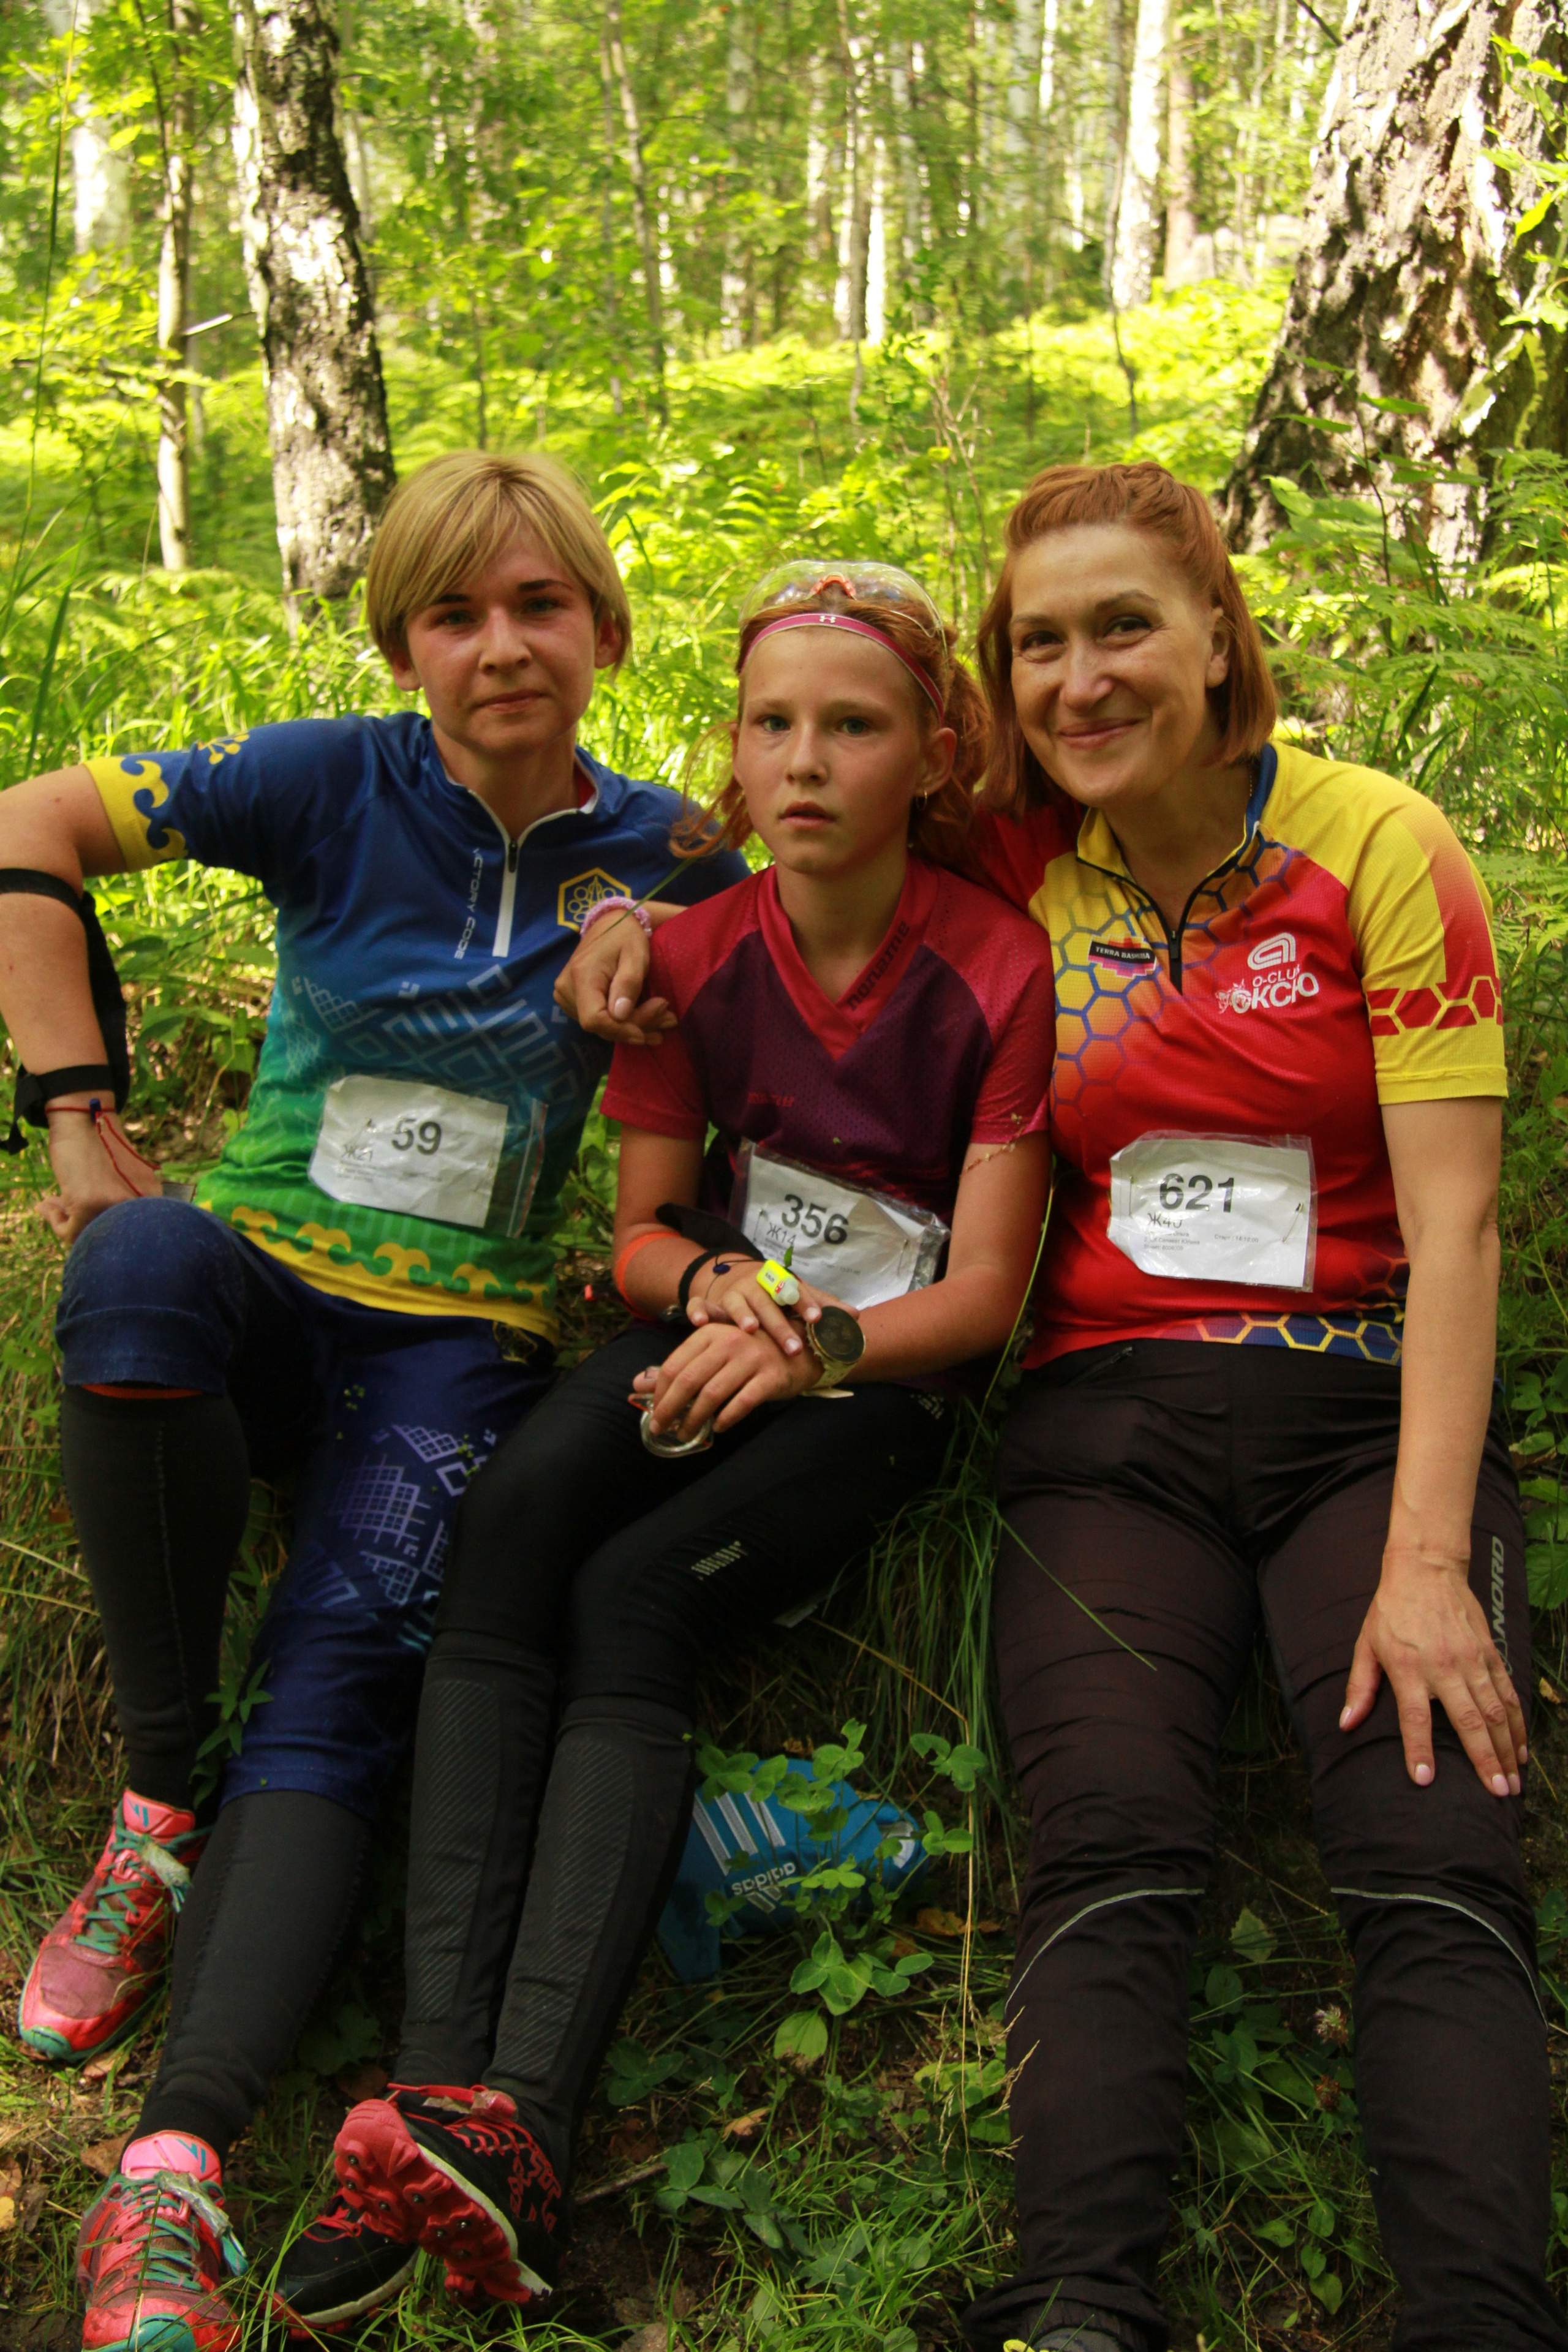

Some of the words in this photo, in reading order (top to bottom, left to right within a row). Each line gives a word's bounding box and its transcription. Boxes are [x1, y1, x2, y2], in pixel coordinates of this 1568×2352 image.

[454, 916, 476, 960] CODE
[1096, 946, 1120, 957] TERRA
[848, 921, 910, 1011] noname
[391, 1118, 442, 1155] 59
[1159, 1174, 1234, 1213] 621
[767, 1223, 796, 1246] Ж14
[782, 1194, 849, 1244] 356
[1491, 1536, 1506, 1639] NORD
[731, 1861, 796, 1896] adidas
